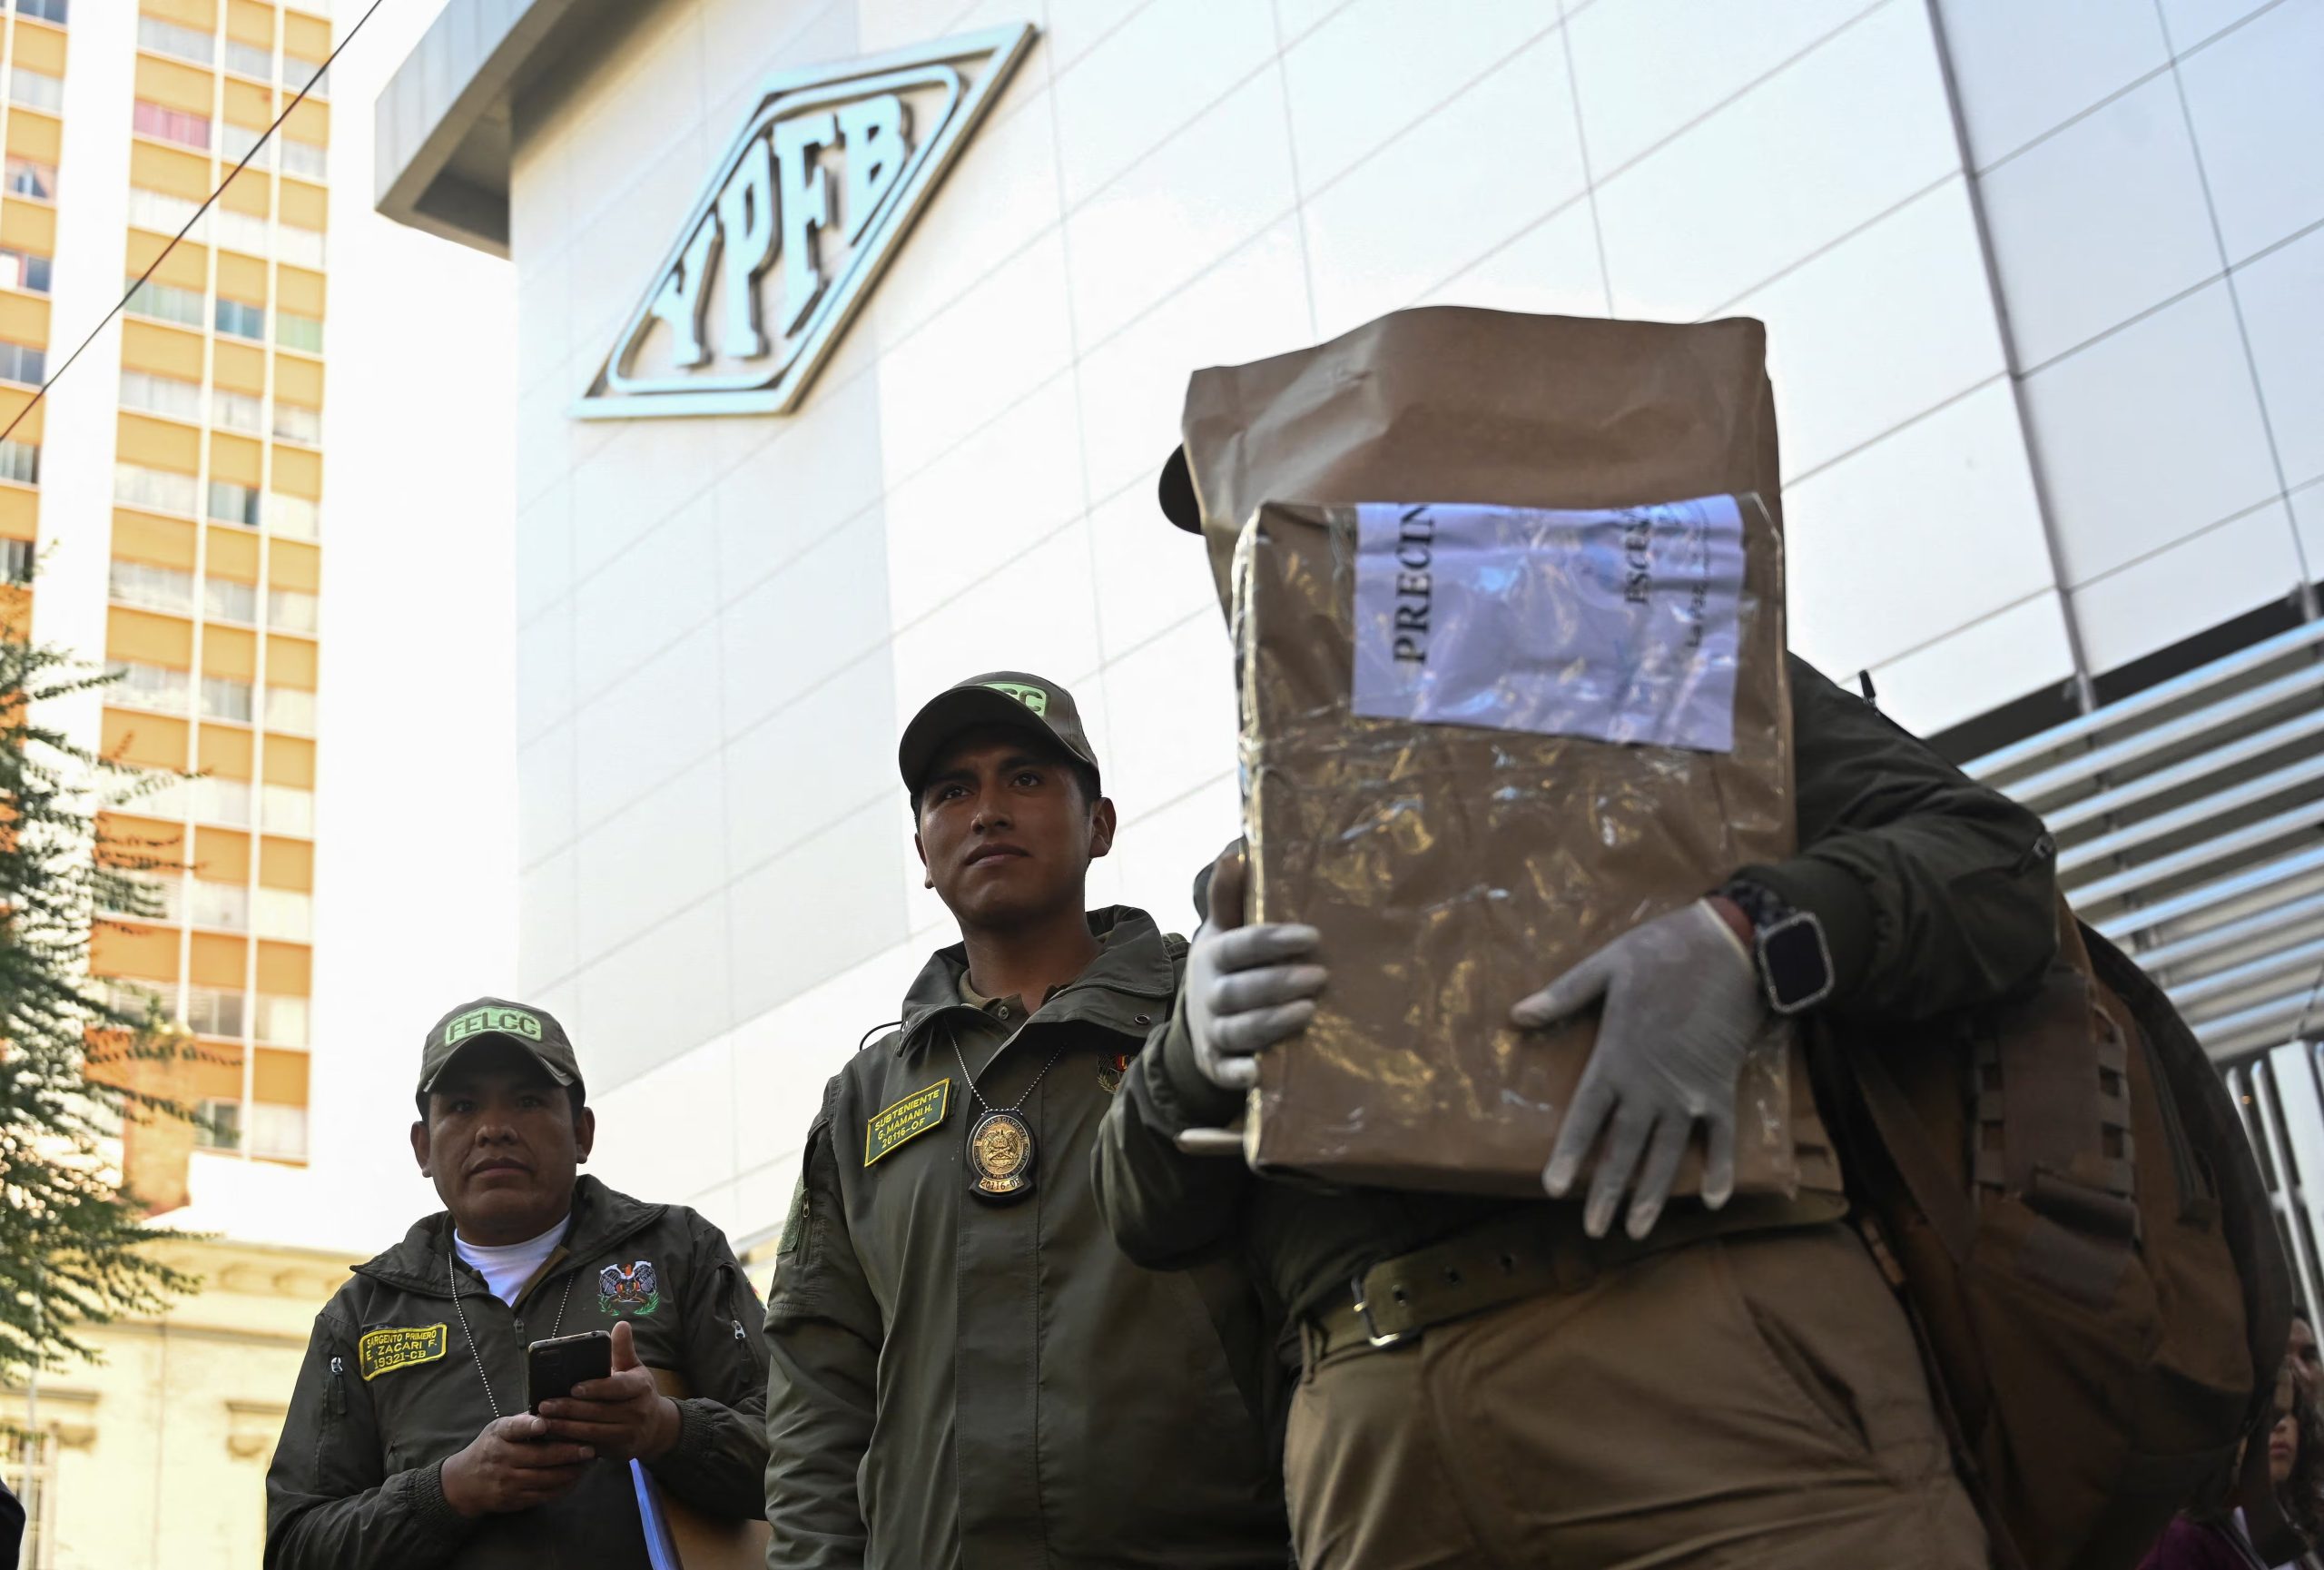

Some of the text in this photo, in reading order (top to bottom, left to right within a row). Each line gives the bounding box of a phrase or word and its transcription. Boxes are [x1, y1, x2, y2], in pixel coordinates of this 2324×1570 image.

[649, 94, 906, 367] YPFB
[448, 1011, 538, 1042] FELCC
[874, 1089, 940, 1131] SUBTENIENTE
[886, 1108, 923, 1135] MAMANI
[924, 1104, 933, 1114] H.
[881, 1117, 926, 1149] 20116-OF
[367, 1329, 437, 1348] SARGENTO PRIMERO
[378, 1341, 422, 1356] ZACARI
[428, 1339, 438, 1348] F.
[373, 1350, 427, 1369] 19321-CB
